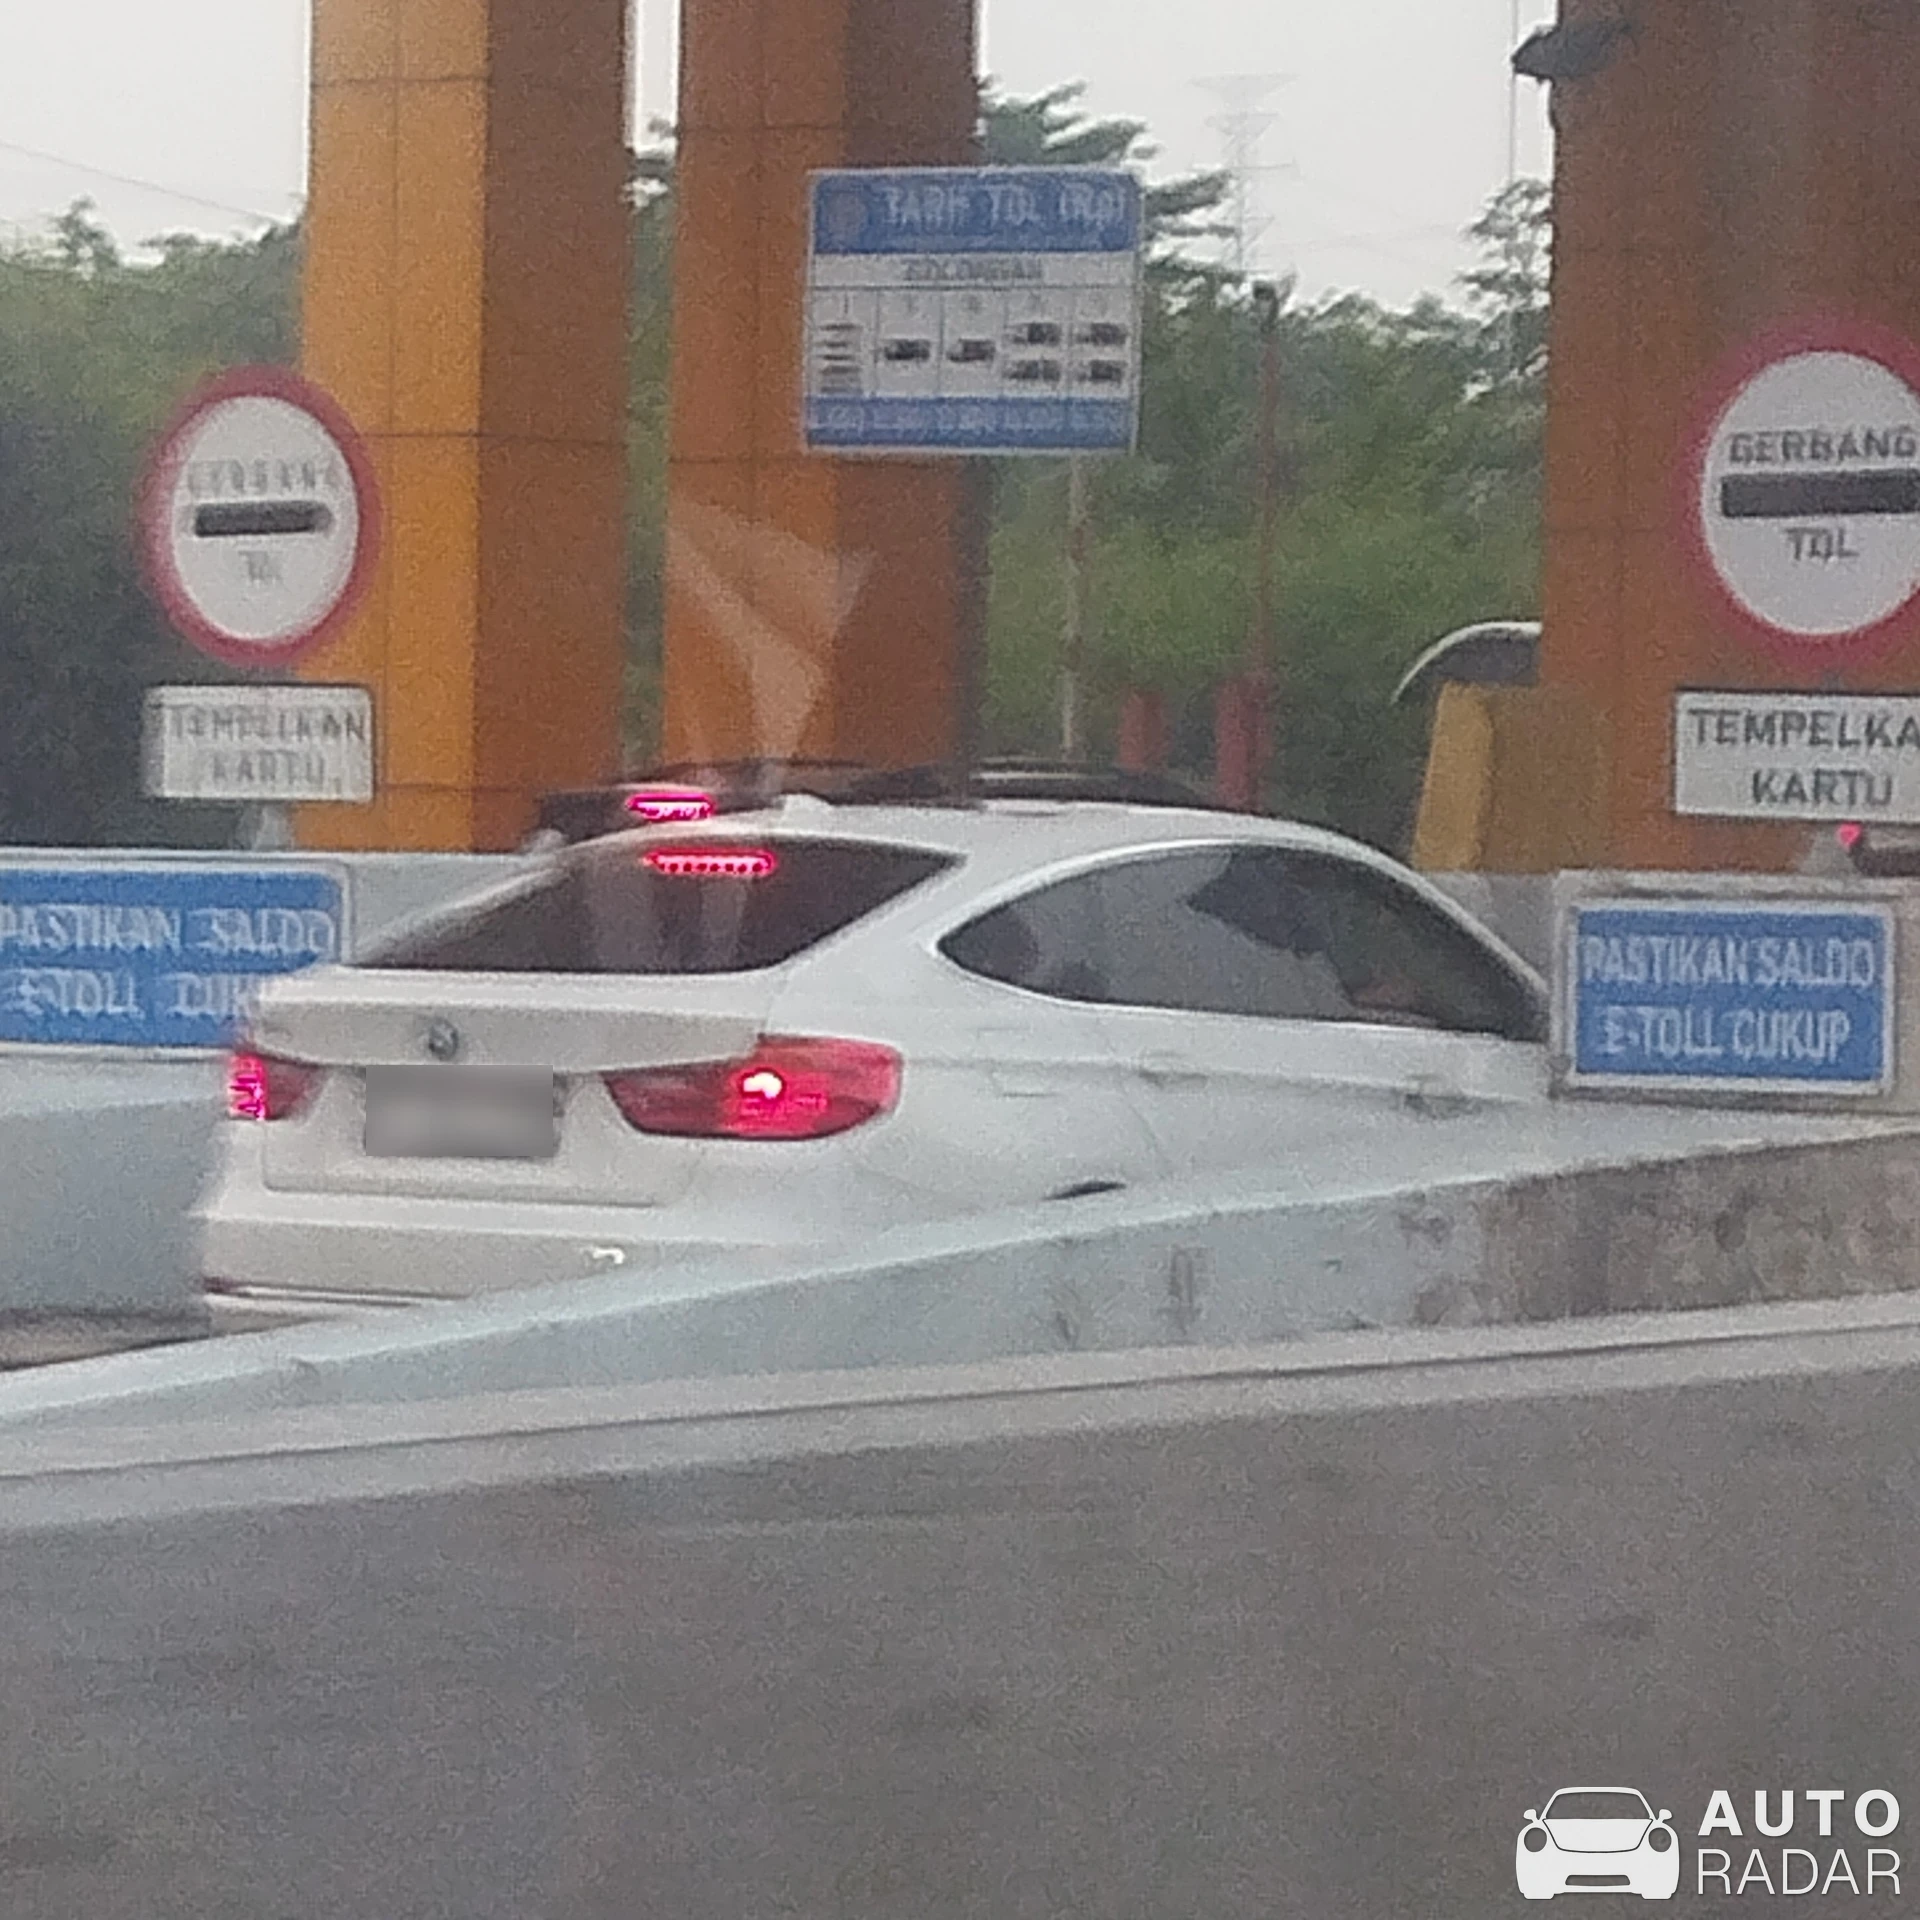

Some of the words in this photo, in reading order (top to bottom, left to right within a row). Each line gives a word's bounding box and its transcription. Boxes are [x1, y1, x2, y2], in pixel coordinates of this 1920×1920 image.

[1728, 427, 1917, 464] GERBANG
[1785, 525, 1859, 560] TOL
[1687, 709, 1920, 748] TEMPELKA
[1752, 768, 1893, 805] KARTU
[1580, 935, 1750, 984] PASTIKAN
[1753, 937, 1877, 987] SALDO
[1602, 1005, 1722, 1056] E-TOLL
[1726, 1009, 1851, 1063] CUKUP
